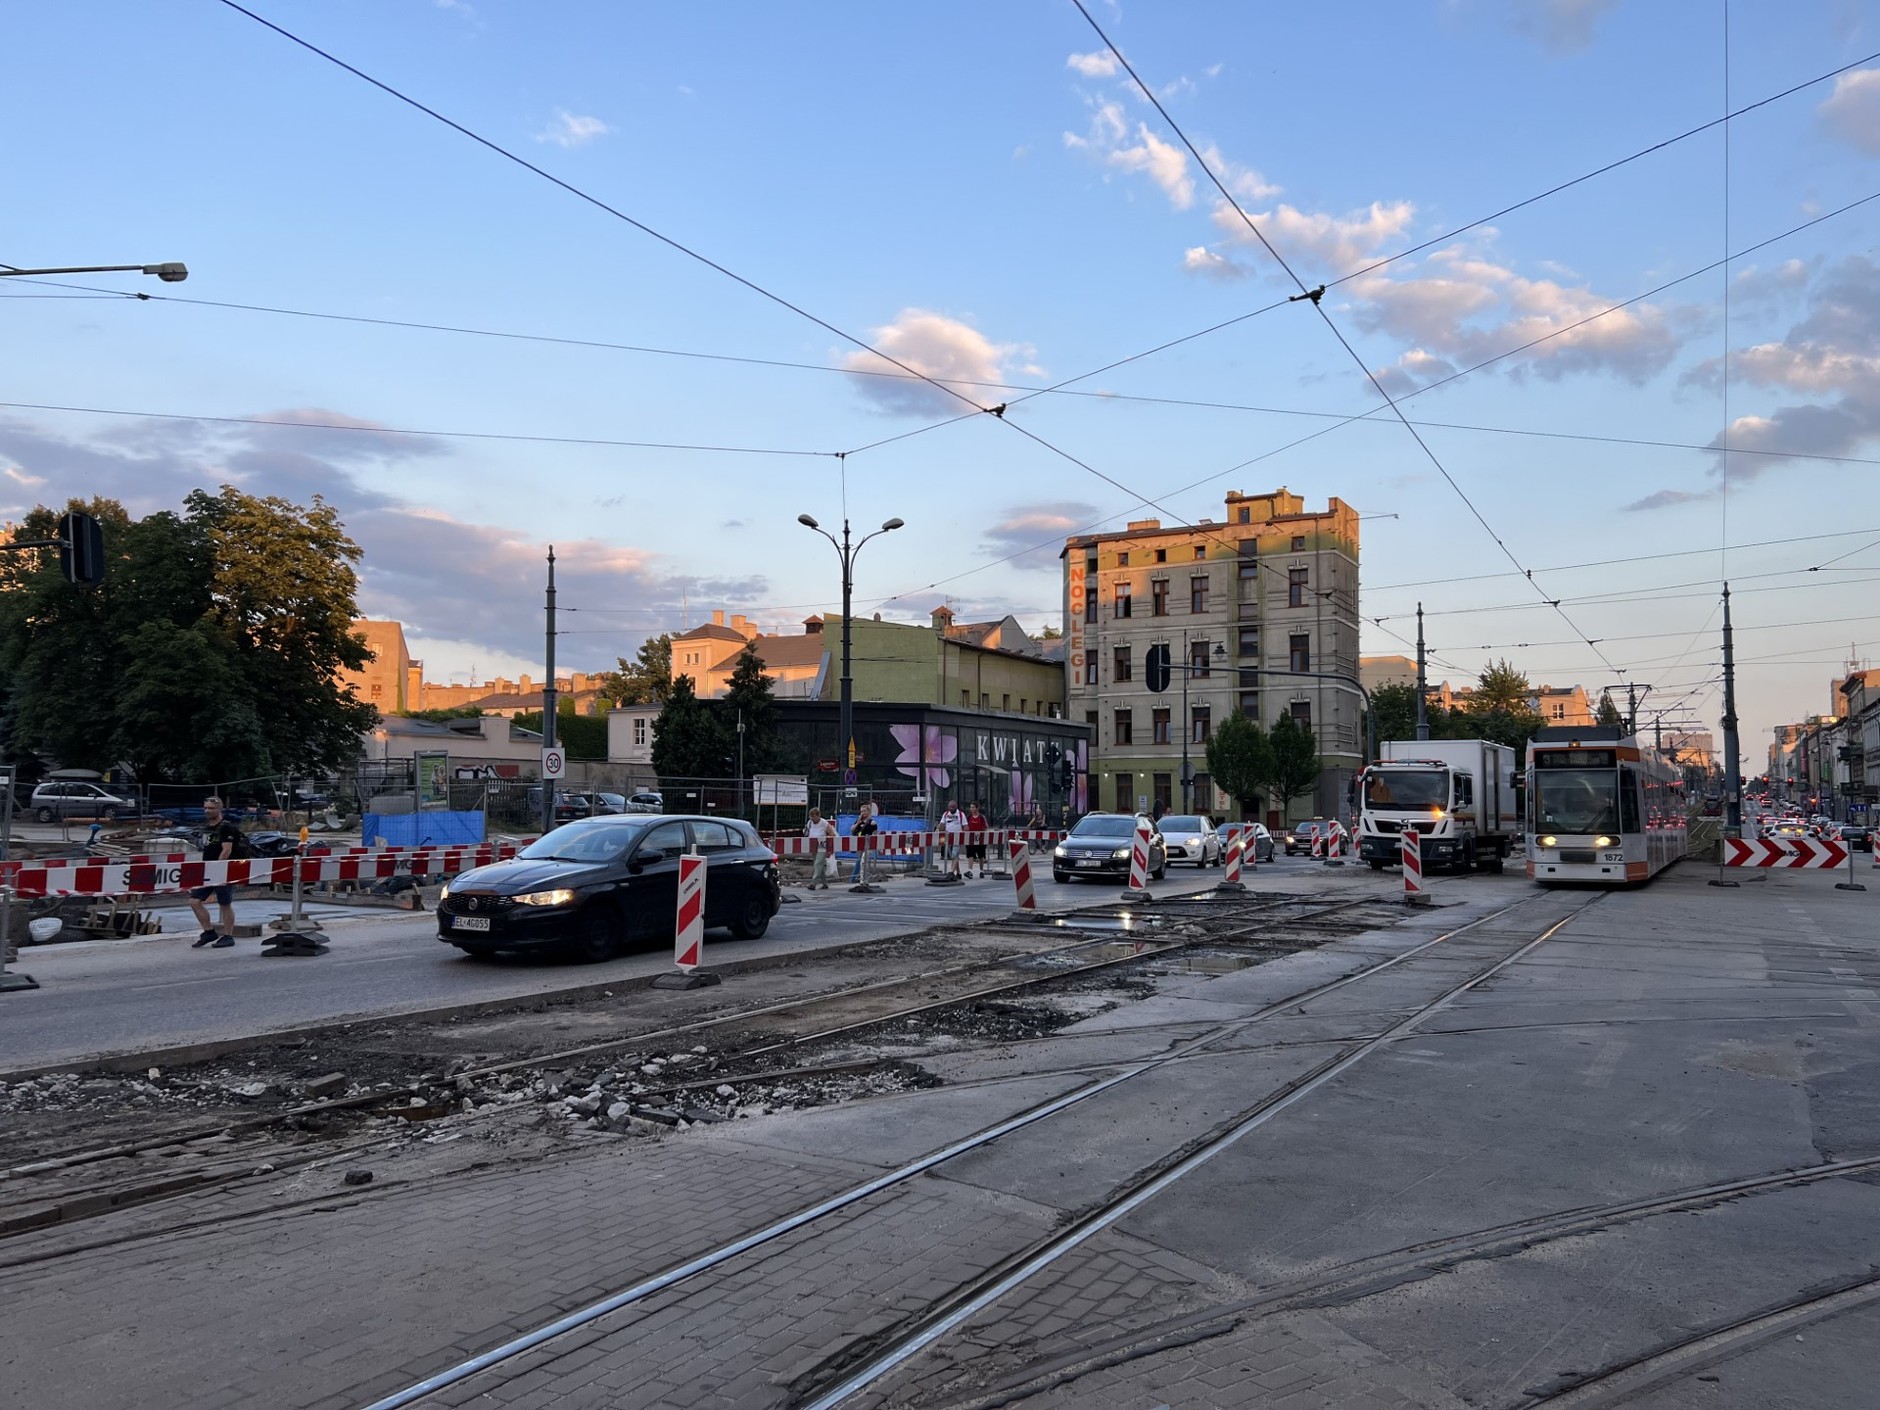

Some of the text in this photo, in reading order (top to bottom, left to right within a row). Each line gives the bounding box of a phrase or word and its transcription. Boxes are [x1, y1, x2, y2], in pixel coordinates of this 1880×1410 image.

[1071, 568, 1084, 684] NOCLEGI
[548, 758, 559, 769] 30
[1604, 853, 1624, 862] 1872
